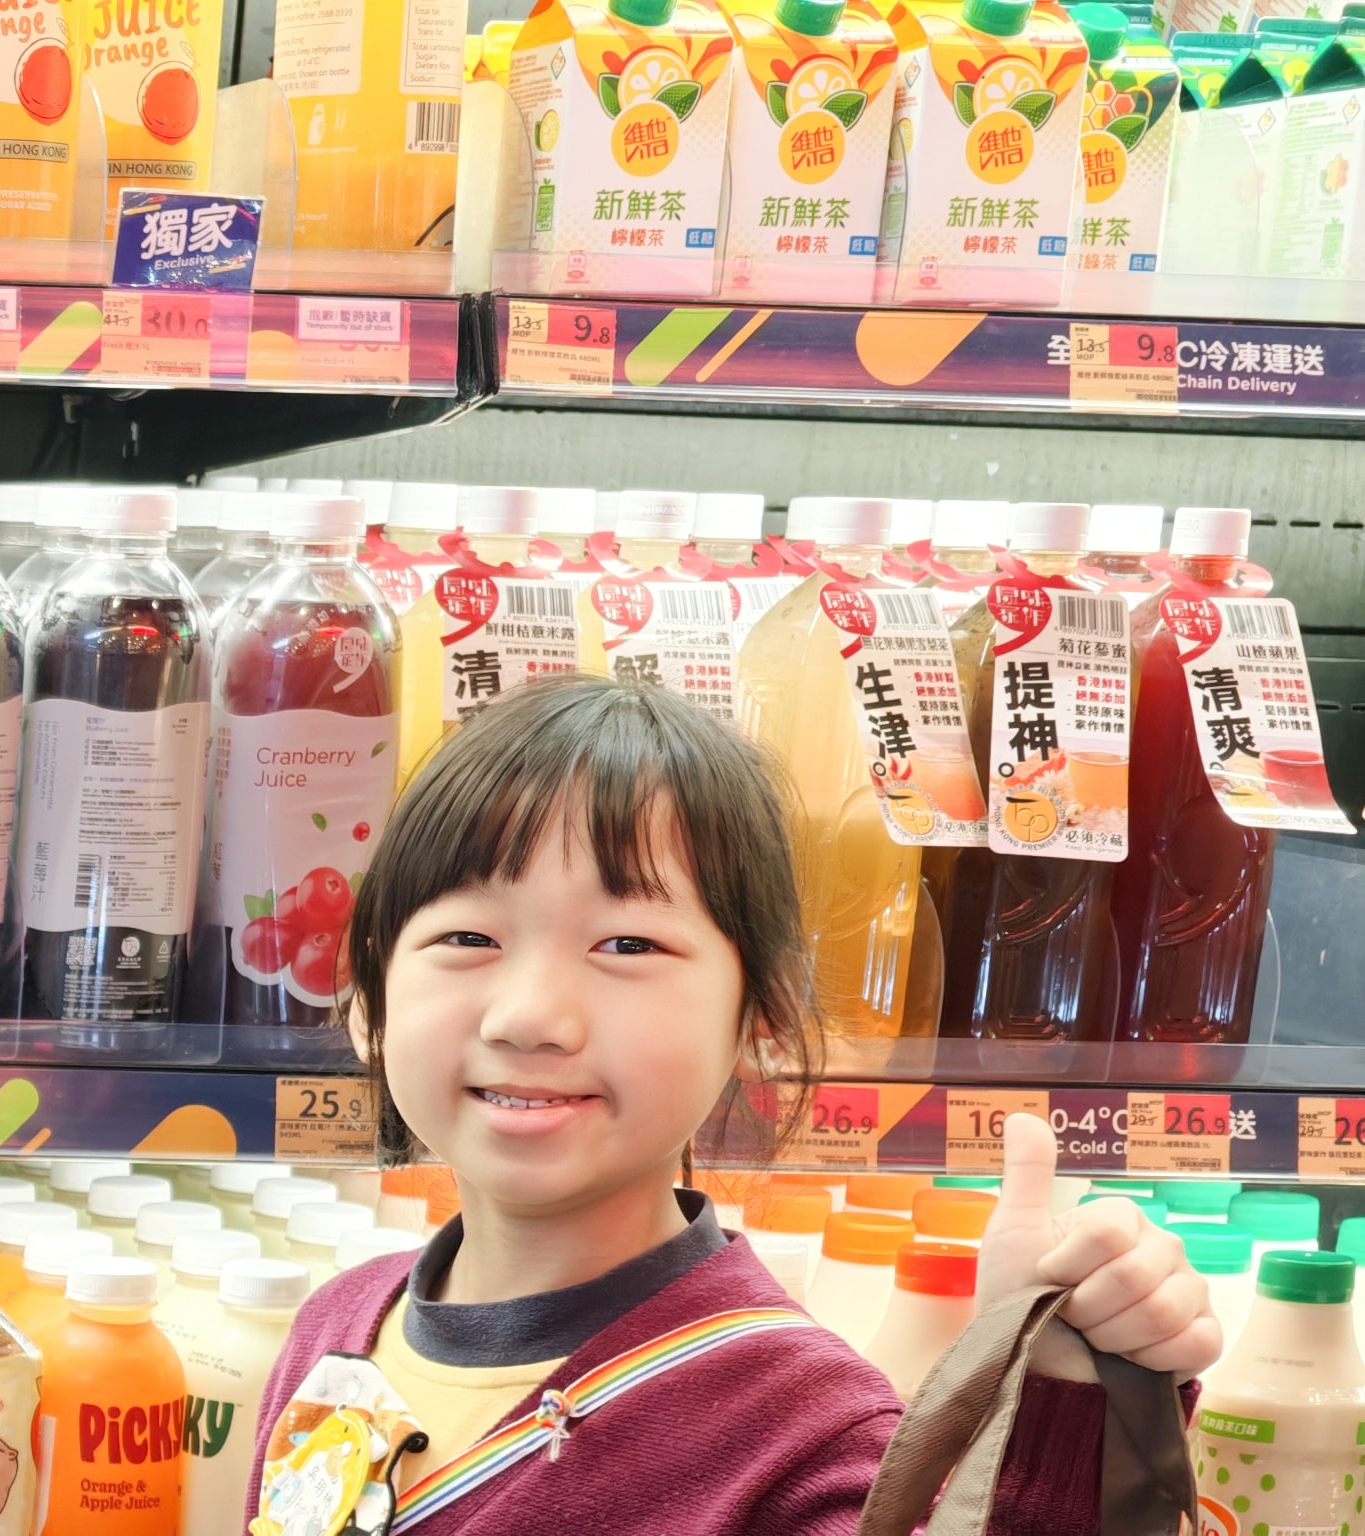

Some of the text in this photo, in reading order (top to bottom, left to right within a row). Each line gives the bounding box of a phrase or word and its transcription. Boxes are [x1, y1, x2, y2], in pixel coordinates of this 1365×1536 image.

[2, 143, 39, 157] HONG
[41, 146, 67, 159] KONG
[125, 163, 162, 176] HONG
[165, 164, 193, 177] KONG
[593, 188, 686, 222] 新鮮茶
[759, 196, 850, 229] 新鮮茶
[947, 196, 1040, 229] 新鮮茶
[141, 203, 236, 259] 獨家
[610, 228, 664, 248] 檸檬茶
[776, 235, 828, 253] 檸檬茶
[963, 235, 1017, 254] 檸檬茶
[574, 314, 610, 345] 9.8
[1138, 335, 1174, 363] 9.8
[1240, 377, 1297, 396] Delivery
[256, 746, 357, 767] Cranberry
[254, 769, 307, 788] Juice
[299, 1089, 363, 1120] 25.9
[812, 1104, 873, 1135] 26.9
[1165, 1106, 1227, 1136] 26.9
[80, 1477, 147, 1498] Orange &
[80, 1495, 161, 1514] Apple Juice
